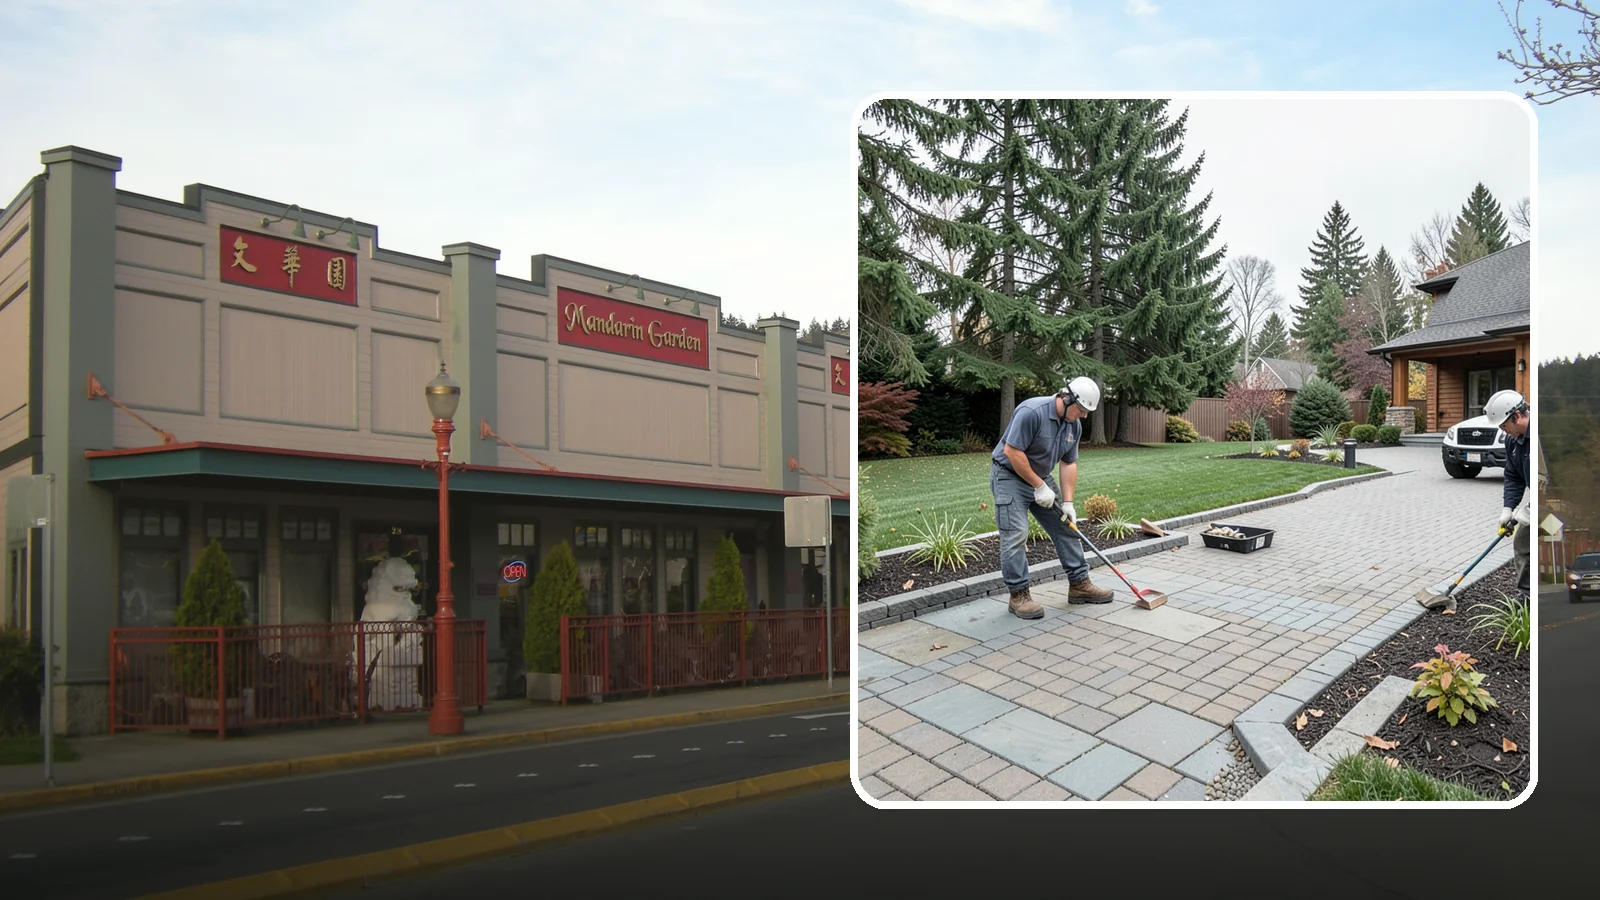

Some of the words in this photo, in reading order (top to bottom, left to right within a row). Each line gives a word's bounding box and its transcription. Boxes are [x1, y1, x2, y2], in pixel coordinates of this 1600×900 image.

[231, 236, 346, 290] 文華園
[564, 302, 643, 341] Mandarin
[648, 320, 701, 352] Garden
[503, 565, 527, 578] OPEN
